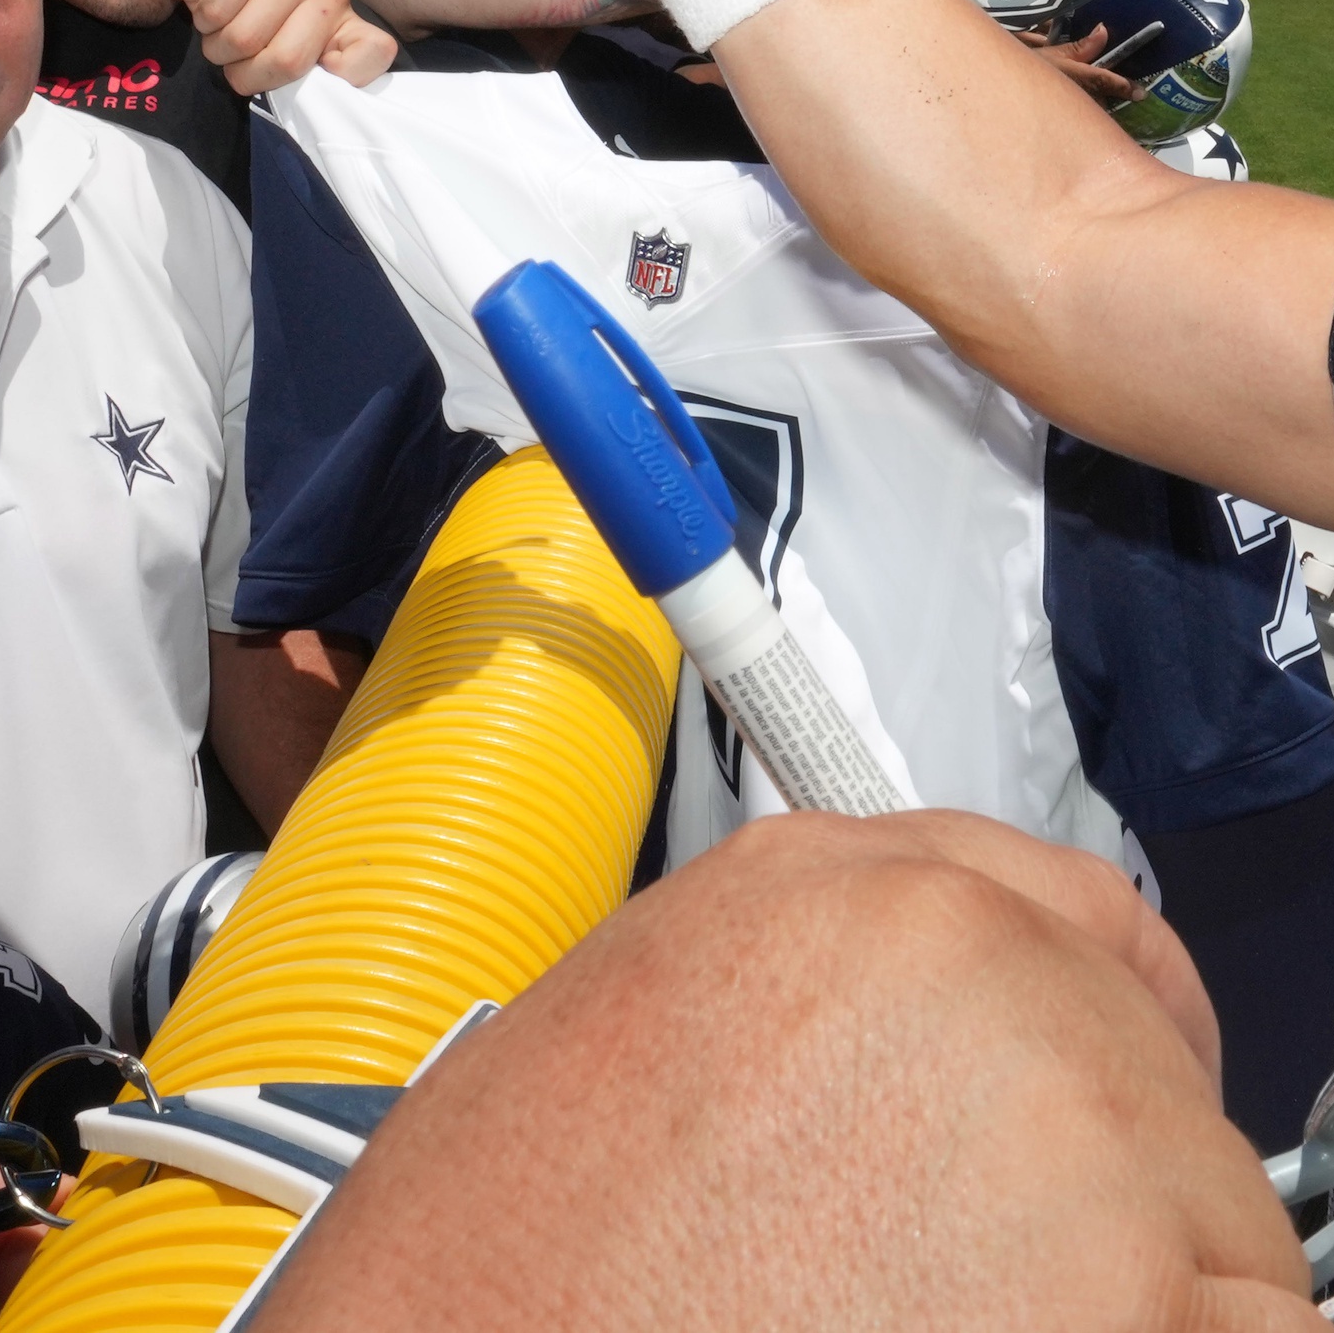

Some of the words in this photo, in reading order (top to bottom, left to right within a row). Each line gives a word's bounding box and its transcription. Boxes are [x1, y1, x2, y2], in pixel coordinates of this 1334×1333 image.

[635, 260, 674, 295] NFL
[607, 409, 703, 537] Sharpie
[714, 678, 732, 703] Made
[730, 704, 739, 713] in
[728, 671, 742, 688] sur
[738, 687, 749, 698] la
[745, 696, 770, 731] surface
[765, 730, 782, 752] pour
[780, 751, 803, 784] saturer
[799, 782, 809, 793] la
[740, 664, 768, 702] Appuyer
[764, 701, 774, 712] la
[769, 712, 791, 740] pointe
[788, 739, 800, 753] du
[796, 752, 826, 795] marqueur
[765, 648, 775, 658] la
[770, 658, 792, 686] pointe
[789, 686, 805, 708] avec
[802, 707, 812, 718] le
[824, 743, 852, 782] Replacer
[848, 780, 858, 791] le
[854, 791, 873, 817] capuc
[766, 677, 791, 712] secouer
[788, 713, 805, 734] pour
[827, 773, 838, 784] la
[774, 639, 784, 650] la
[780, 650, 801, 678] pointe
[798, 678, 809, 690] du
[806, 691, 834, 732] marqueur
[831, 733, 846, 752] vers
[844, 752, 852, 762] le
